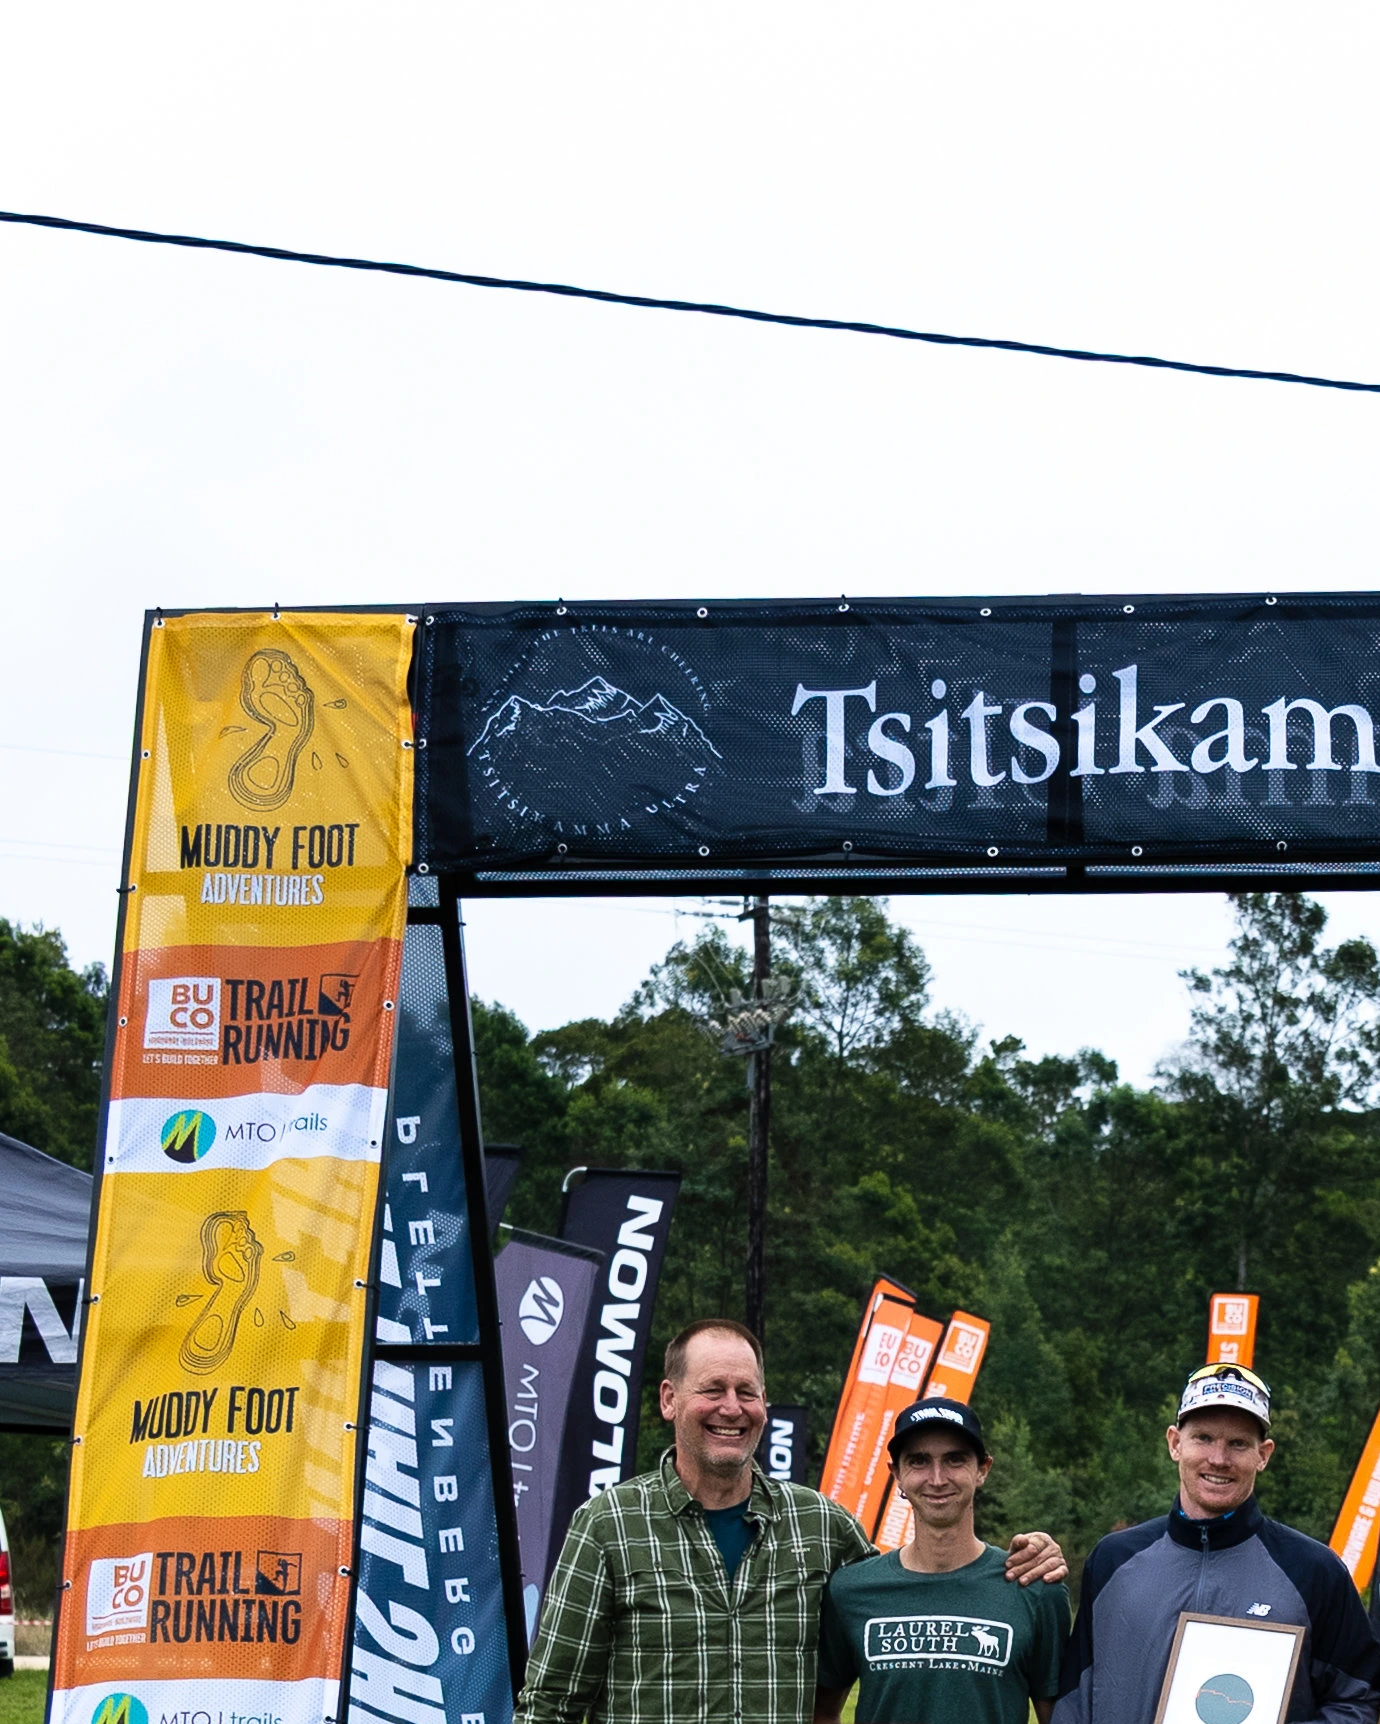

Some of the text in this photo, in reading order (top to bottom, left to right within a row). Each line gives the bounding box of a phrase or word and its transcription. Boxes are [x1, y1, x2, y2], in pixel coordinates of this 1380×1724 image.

[645, 765, 707, 814] ULTRA
[180, 823, 360, 870] MUDDY FOOT
[201, 873, 325, 906] ADVENTURES
[171, 984, 214, 1006] BU
[225, 977, 313, 1021] TRAIL
[170, 1007, 214, 1029] CO
[222, 1012, 351, 1066] RUNNING
[225, 1122, 276, 1142] MTO
[288, 1113, 328, 1133] rails
[588, 1195, 664, 1499] ALOMON
[129, 1386, 300, 1444] MUDDY FOOT
[508, 1363, 540, 1452] MTO
[143, 1439, 262, 1479] ADVENTURES
[114, 1560, 146, 1588] BU
[156, 1551, 250, 1596] TRAIL
[112, 1584, 144, 1609] CO
[150, 1599, 302, 1645] RUNNING
[878, 1621, 969, 1638] LAUREL
[881, 1637, 958, 1652] SOUTH
